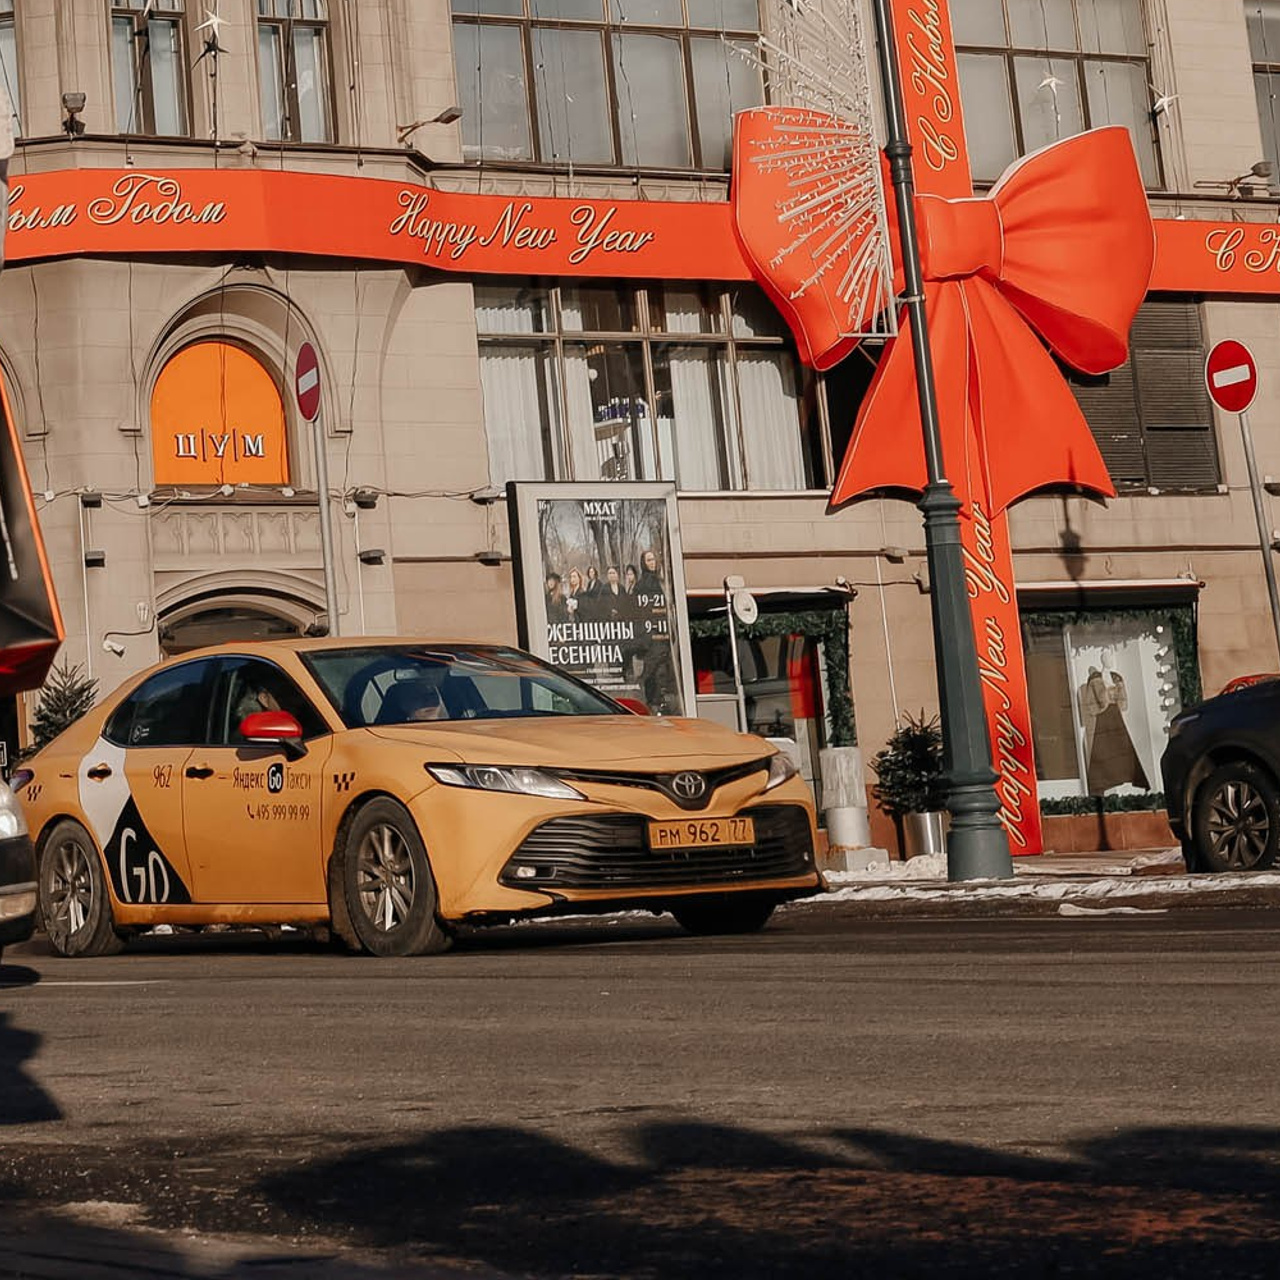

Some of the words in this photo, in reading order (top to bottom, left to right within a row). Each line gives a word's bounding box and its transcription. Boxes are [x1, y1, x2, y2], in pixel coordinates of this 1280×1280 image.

[86, 173, 228, 226] Годом
[389, 189, 478, 260] Happy
[478, 202, 558, 249] New
[567, 205, 656, 265] Year
[583, 501, 617, 515] МХАТ
[962, 500, 1011, 604] Year
[637, 593, 665, 607] 19-21
[547, 622, 634, 644] ЖЕНЩИНЫ
[644, 620, 667, 634] 9-11
[549, 645, 624, 665] ЕСЕНИНА
[979, 616, 1011, 709] New
[154, 765, 173, 789] 962
[232, 767, 265, 792] Яндекс
[269, 766, 282, 789] Go
[286, 767, 312, 790] Такси
[256, 804, 270, 820] 495
[272, 804, 287, 820] 999
[288, 804, 298, 820] 99
[300, 804, 310, 820] 99
[687, 823, 720, 843] 962
[729, 819, 747, 841] 77
[120, 827, 170, 903] Go
